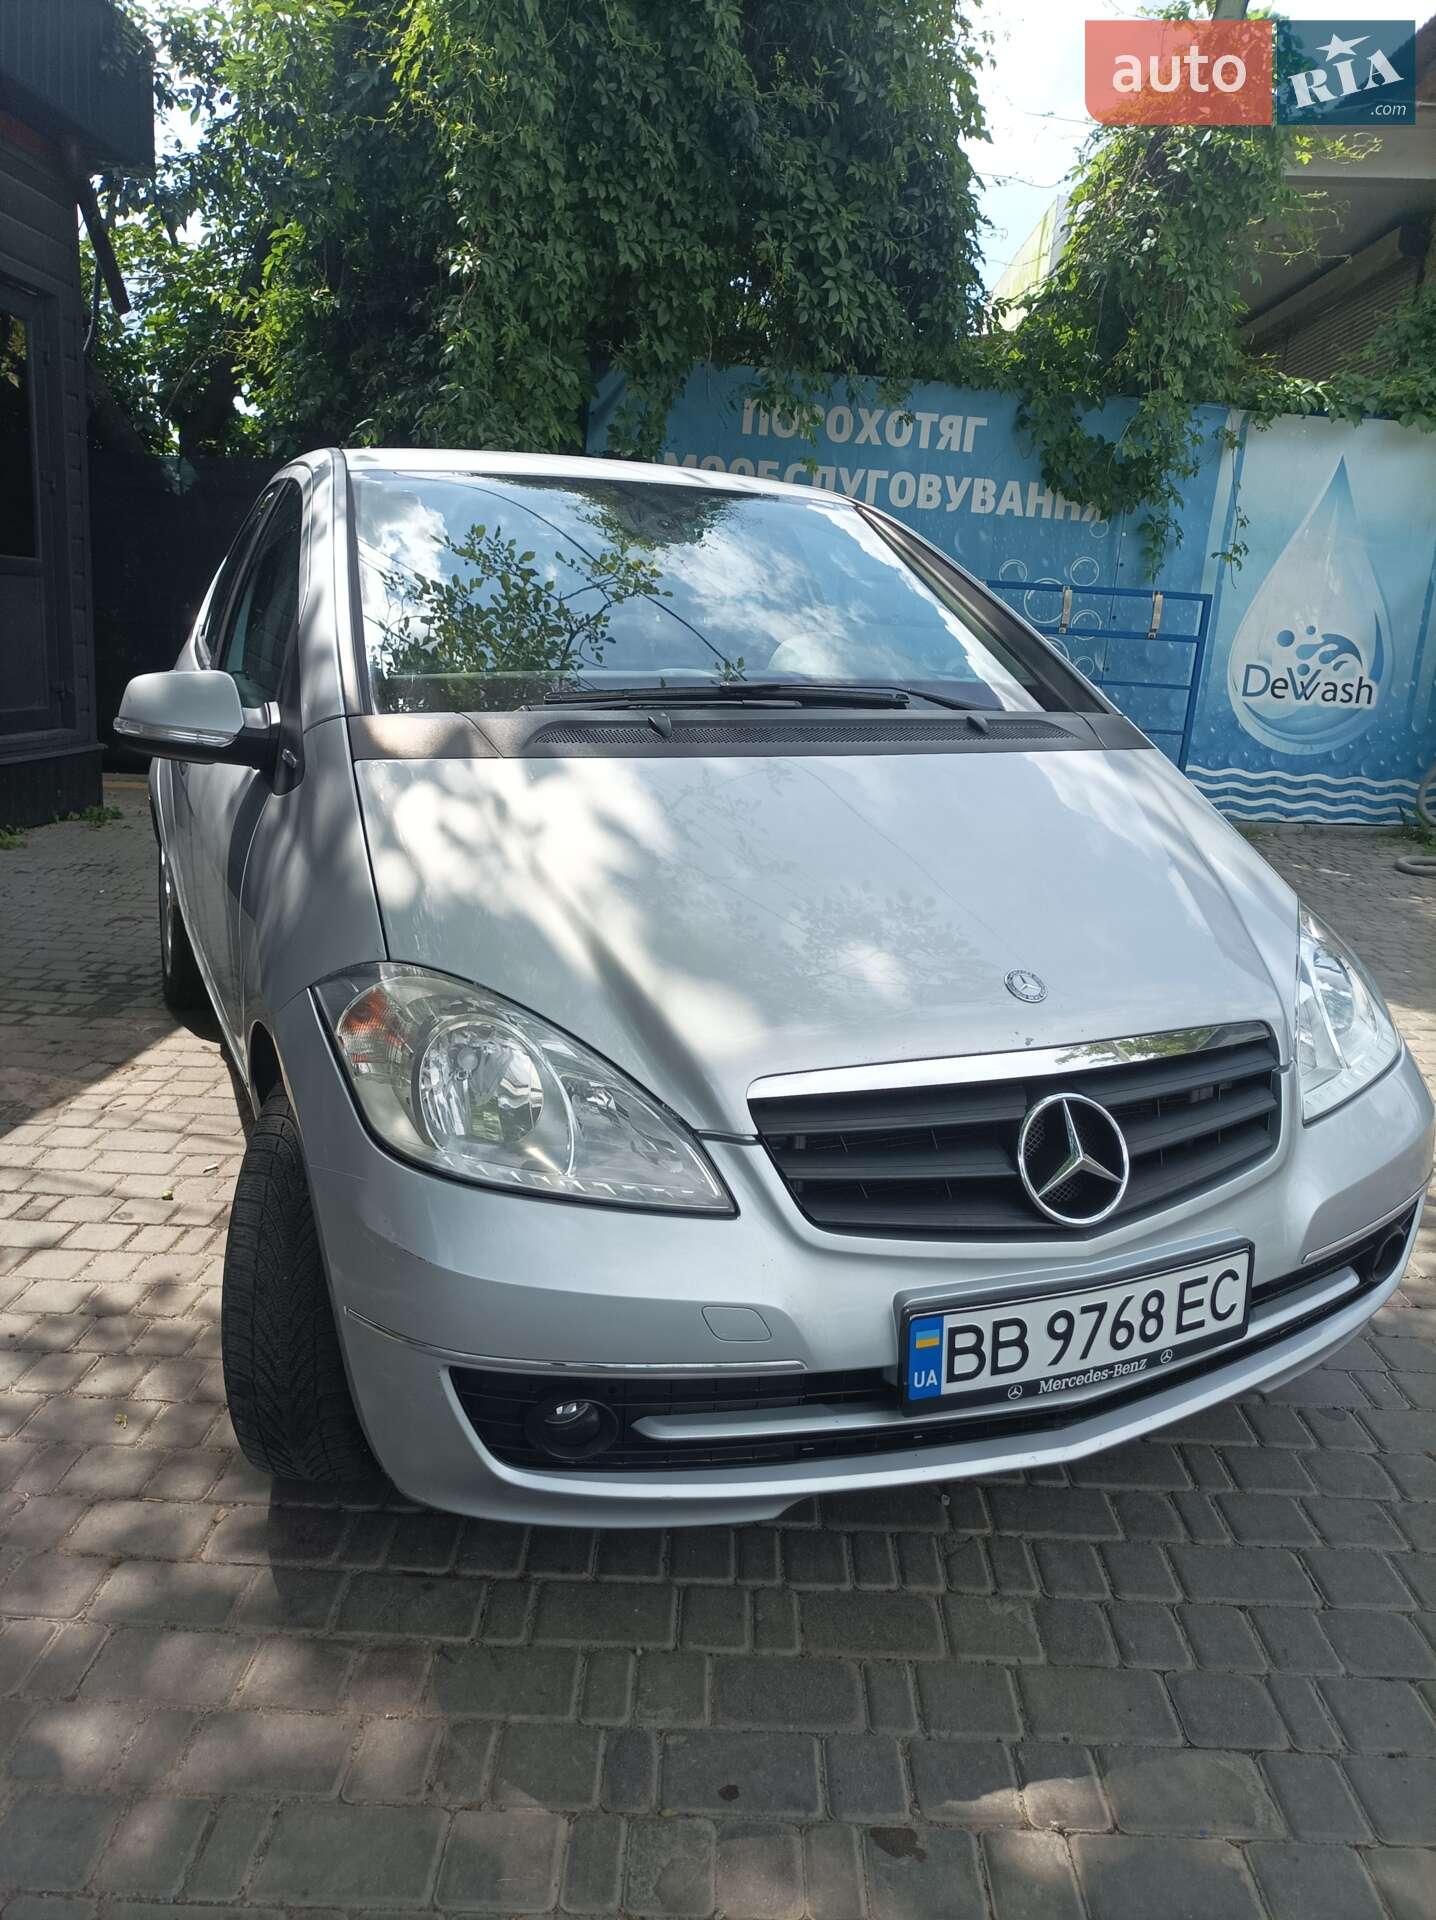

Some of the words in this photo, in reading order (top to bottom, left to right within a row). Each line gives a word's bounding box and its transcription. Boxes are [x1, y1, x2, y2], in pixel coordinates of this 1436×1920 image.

[1242, 664, 1373, 705] DeWash
[946, 1317, 1030, 1384] BB
[1047, 1289, 1166, 1367] 9768
[1175, 1268, 1240, 1336] EC
[913, 1370, 938, 1388] UA
[1038, 1357, 1147, 1395] Mercedes-Benz
